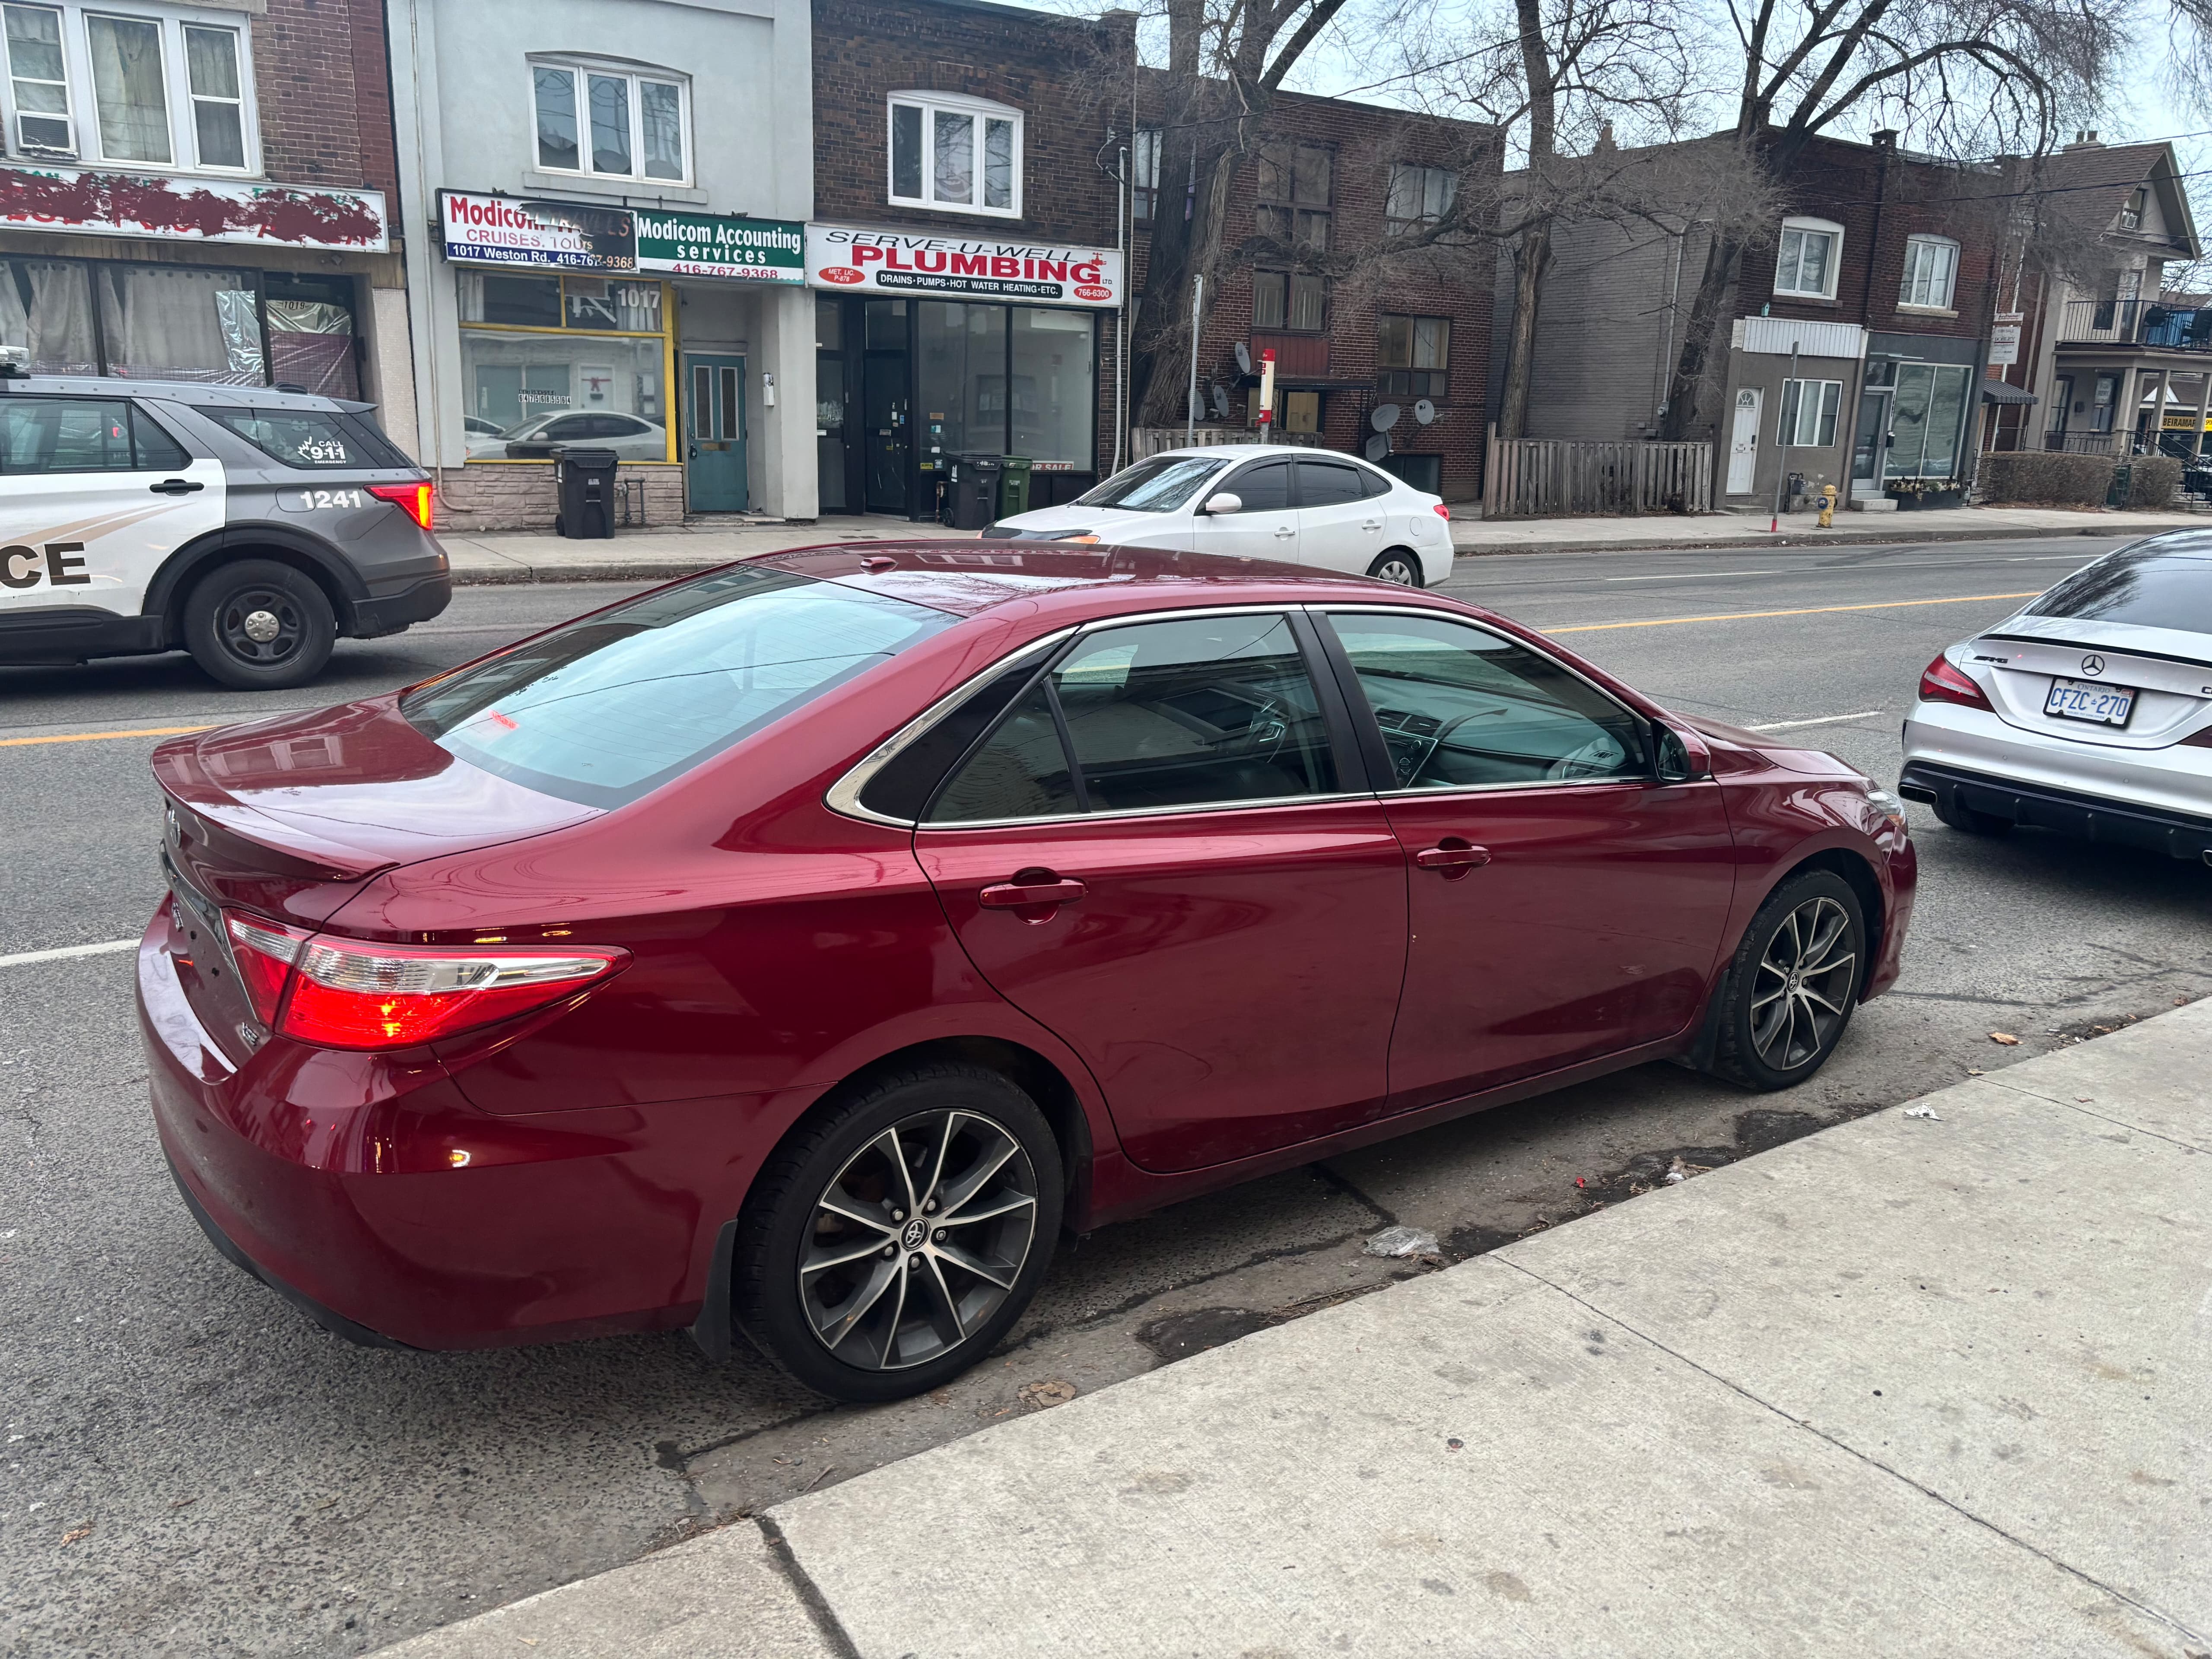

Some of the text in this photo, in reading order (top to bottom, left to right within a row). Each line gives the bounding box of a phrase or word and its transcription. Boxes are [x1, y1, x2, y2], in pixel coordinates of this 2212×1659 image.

[638, 217, 801, 254] Modicom Accounting
[453, 245, 480, 257] 1017
[483, 247, 528, 261] Weston
[531, 251, 551, 263] Rd.
[677, 245, 766, 264] services
[826, 232, 1078, 262] SERVE-U-WELL
[673, 263, 778, 279] 416-767-9368
[852, 245, 1100, 284] PLUMBING
[971, 281, 999, 291] WATER
[1078, 288, 1109, 298] 766-6300
[284, 301, 305, 310] 1019
[617, 288, 661, 308] 1017
[310, 446, 346, 460] 9-1-1
[300, 490, 362, 509] 1241
[2077, 683, 2110, 693] ONTARIO
